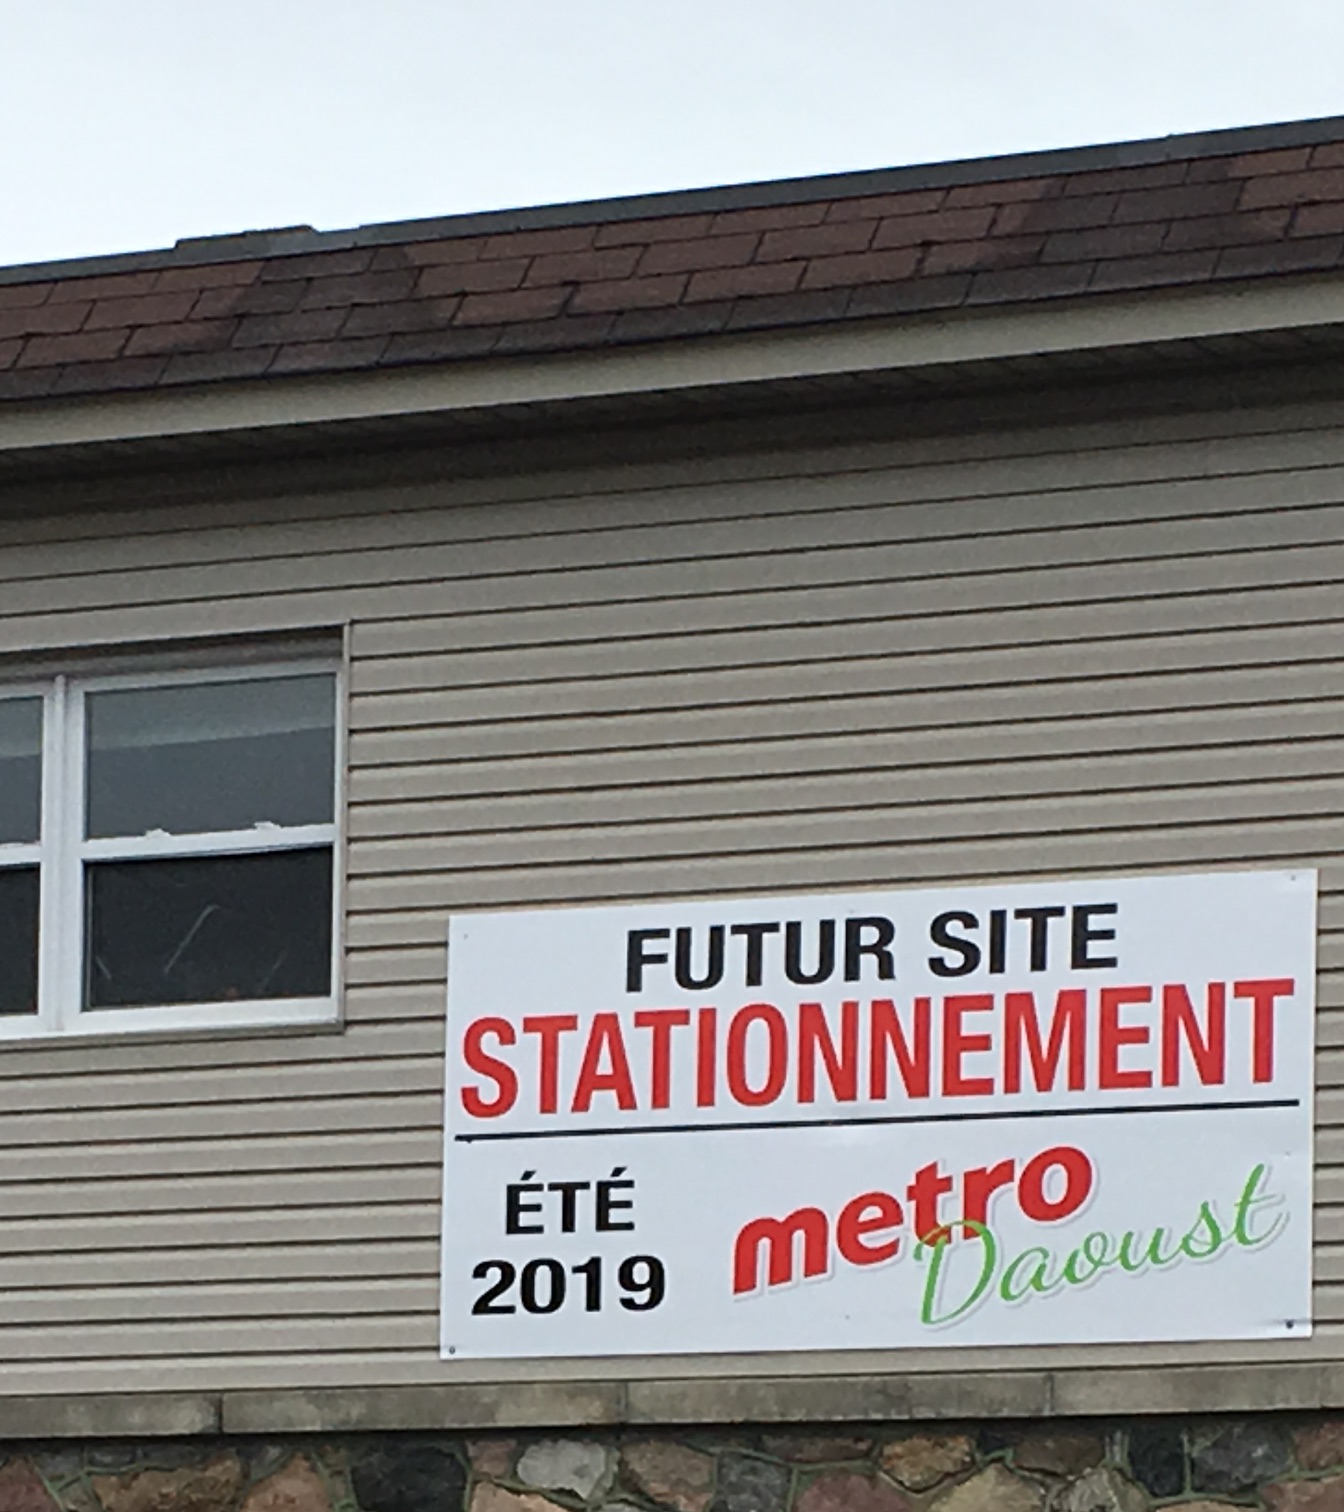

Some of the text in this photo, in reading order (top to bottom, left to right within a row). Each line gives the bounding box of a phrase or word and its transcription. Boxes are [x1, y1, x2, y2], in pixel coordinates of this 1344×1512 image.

[626, 903, 1120, 993] FUTUR SITE
[461, 979, 1295, 1119] STATIONNEMENT
[505, 1167, 636, 1236] ÉTÉ
[733, 1146, 1093, 1296] metro
[914, 1163, 1282, 1326] Daoust
[471, 1254, 666, 1317] 2019
